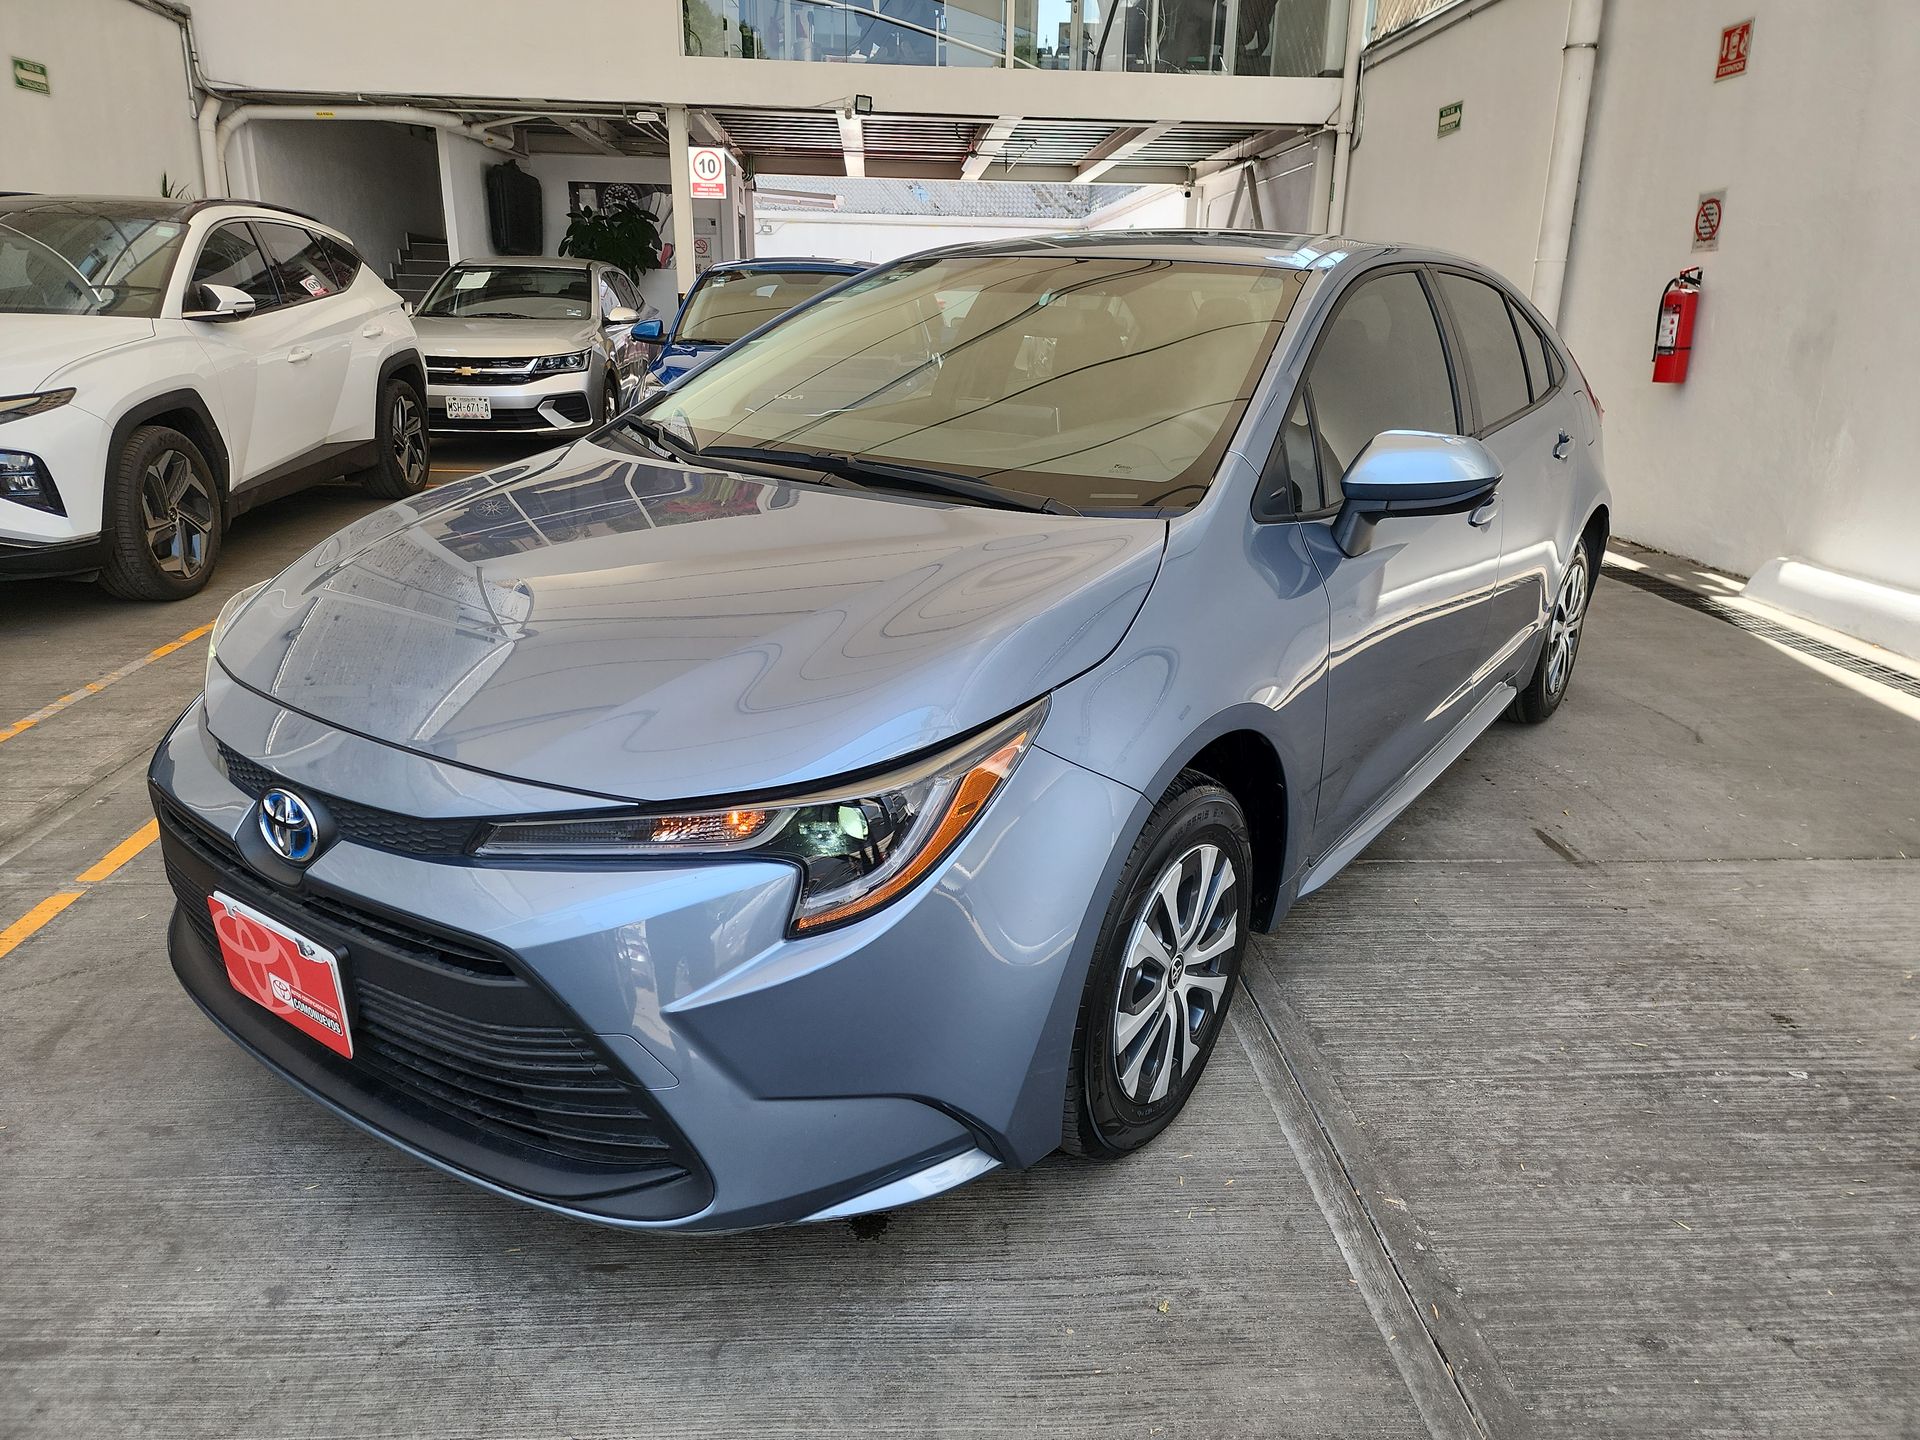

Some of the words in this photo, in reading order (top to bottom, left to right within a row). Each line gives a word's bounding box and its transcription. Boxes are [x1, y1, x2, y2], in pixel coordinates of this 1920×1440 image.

[699, 158, 716, 174] 10
[447, 402, 490, 413] MSH-671-A
[293, 998, 341, 1033] COMONUEVOS
